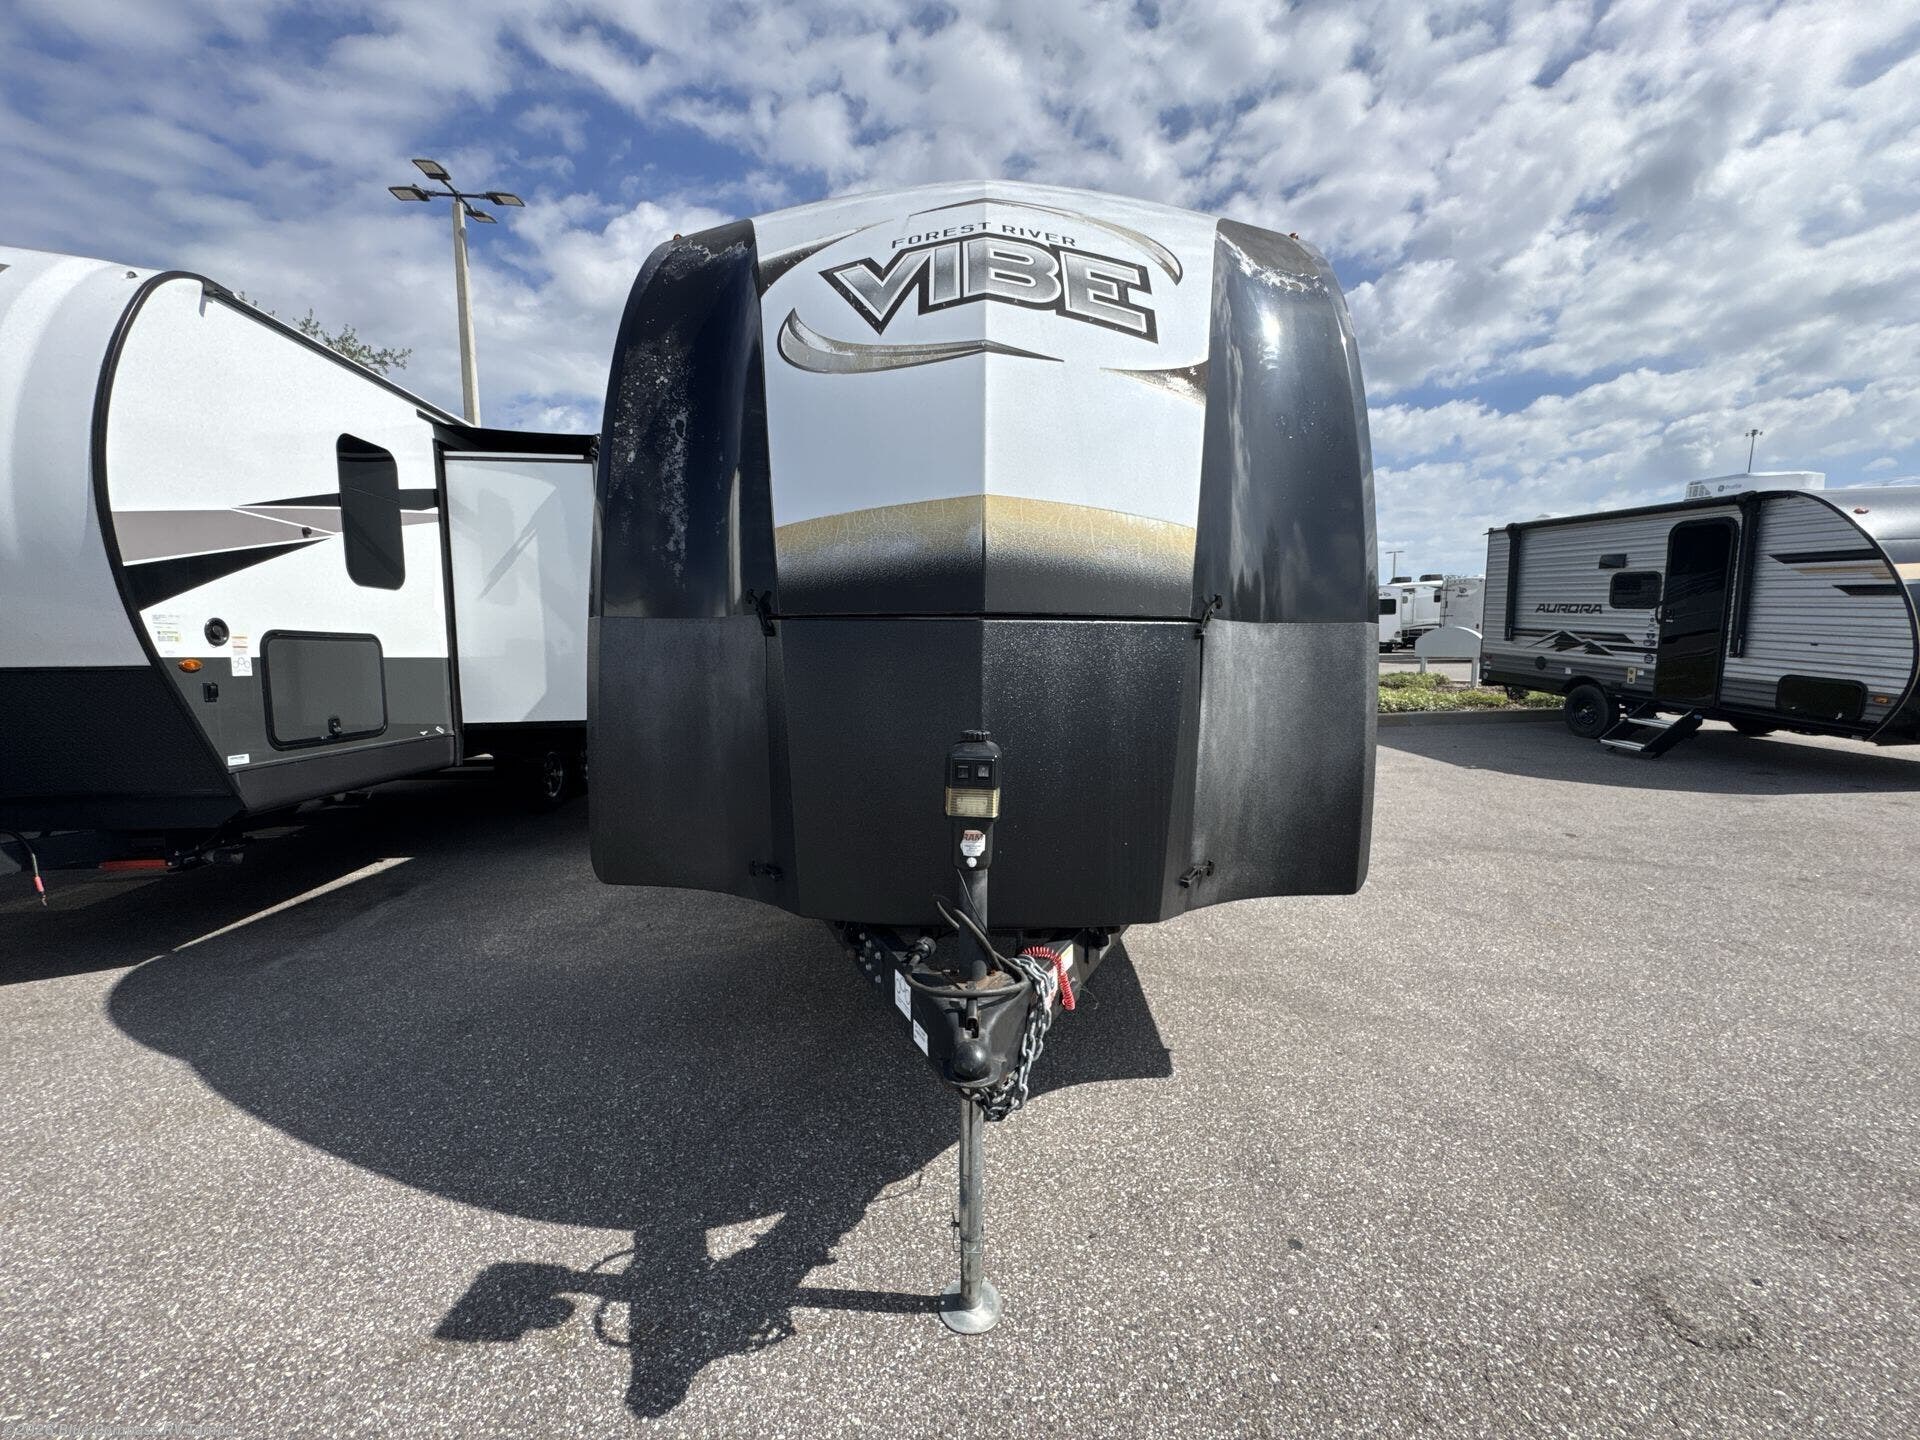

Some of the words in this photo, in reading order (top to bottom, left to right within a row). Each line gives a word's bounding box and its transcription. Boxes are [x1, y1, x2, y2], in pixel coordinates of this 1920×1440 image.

[892, 222, 991, 249] FOREST
[1002, 225, 1076, 247] RIVER
[819, 232, 1158, 344] VIBE
[1535, 603, 1603, 614] AURORA
